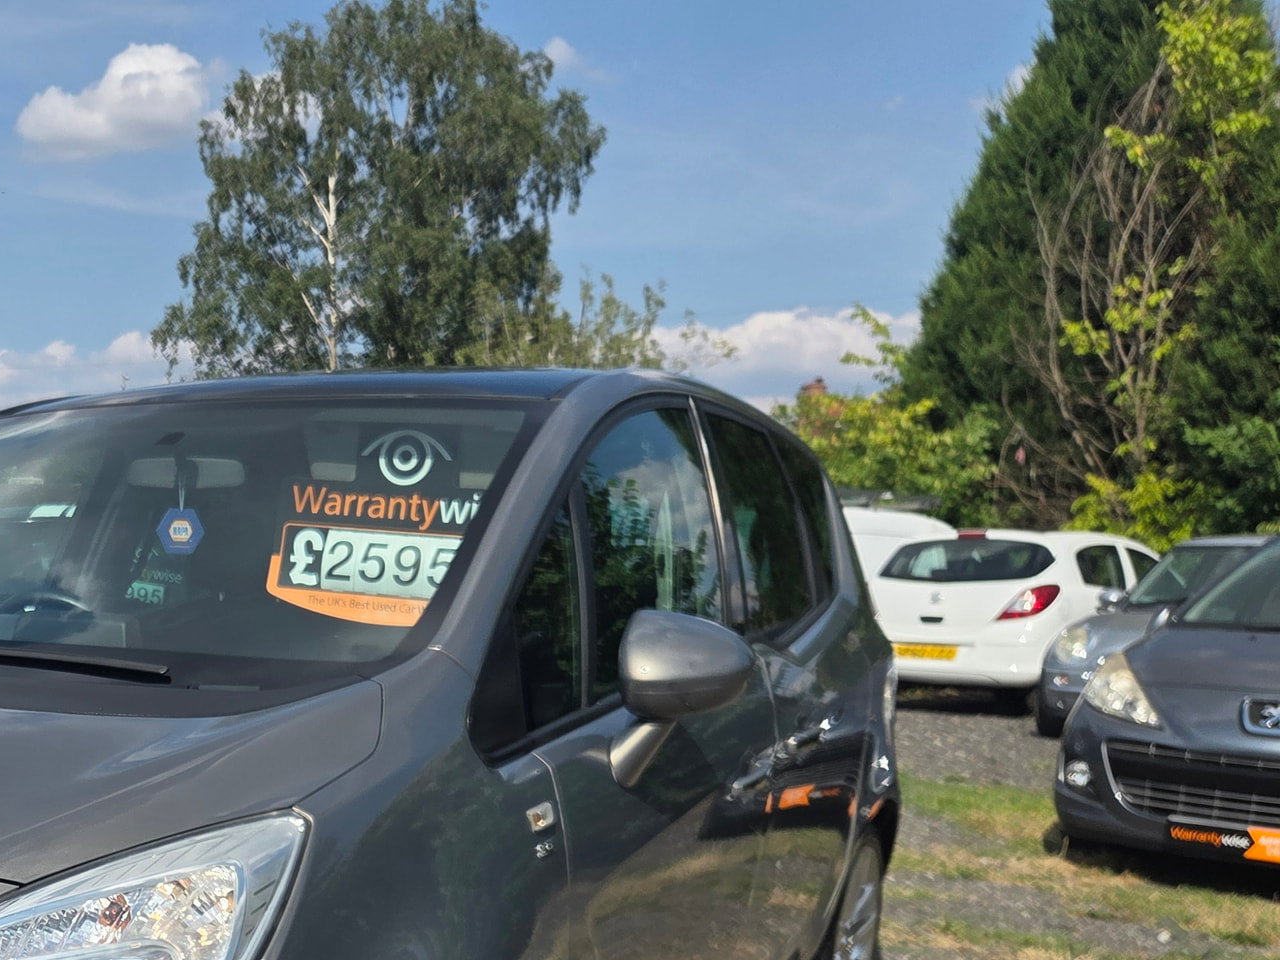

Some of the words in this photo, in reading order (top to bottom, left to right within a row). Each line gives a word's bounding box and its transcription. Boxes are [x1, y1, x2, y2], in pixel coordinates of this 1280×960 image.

[288, 528, 458, 588] £2595
[308, 594, 325, 604] The
[349, 599, 369, 610] Best
[372, 601, 396, 613] Used
[400, 604, 416, 614] Car
